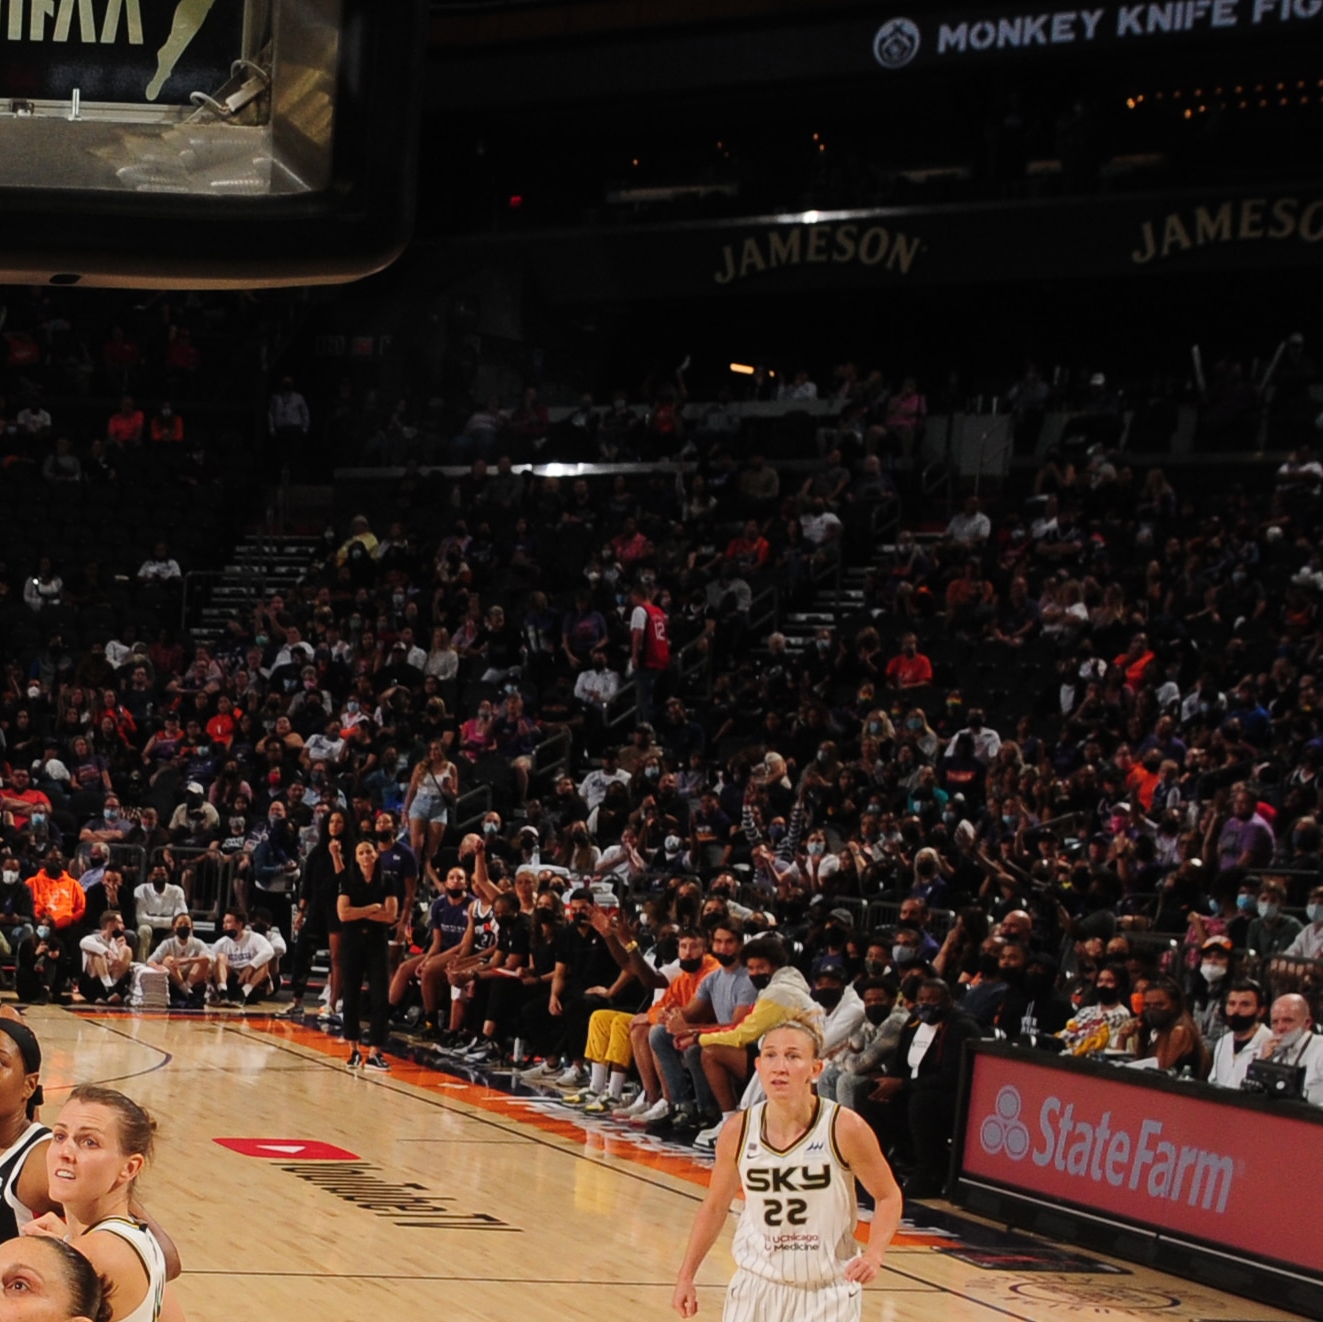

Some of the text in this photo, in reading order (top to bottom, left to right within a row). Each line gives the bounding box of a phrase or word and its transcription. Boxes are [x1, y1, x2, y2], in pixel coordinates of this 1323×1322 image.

[937, 9, 1105, 55] MONKEY
[1116, 0, 1240, 38] KNIFE
[713, 223, 921, 286] JAMESON
[745, 1164, 832, 1193] SKY
[762, 1198, 808, 1227] 22
[773, 1233, 820, 1244] UChicago
[773, 1242, 820, 1252] Medicine
